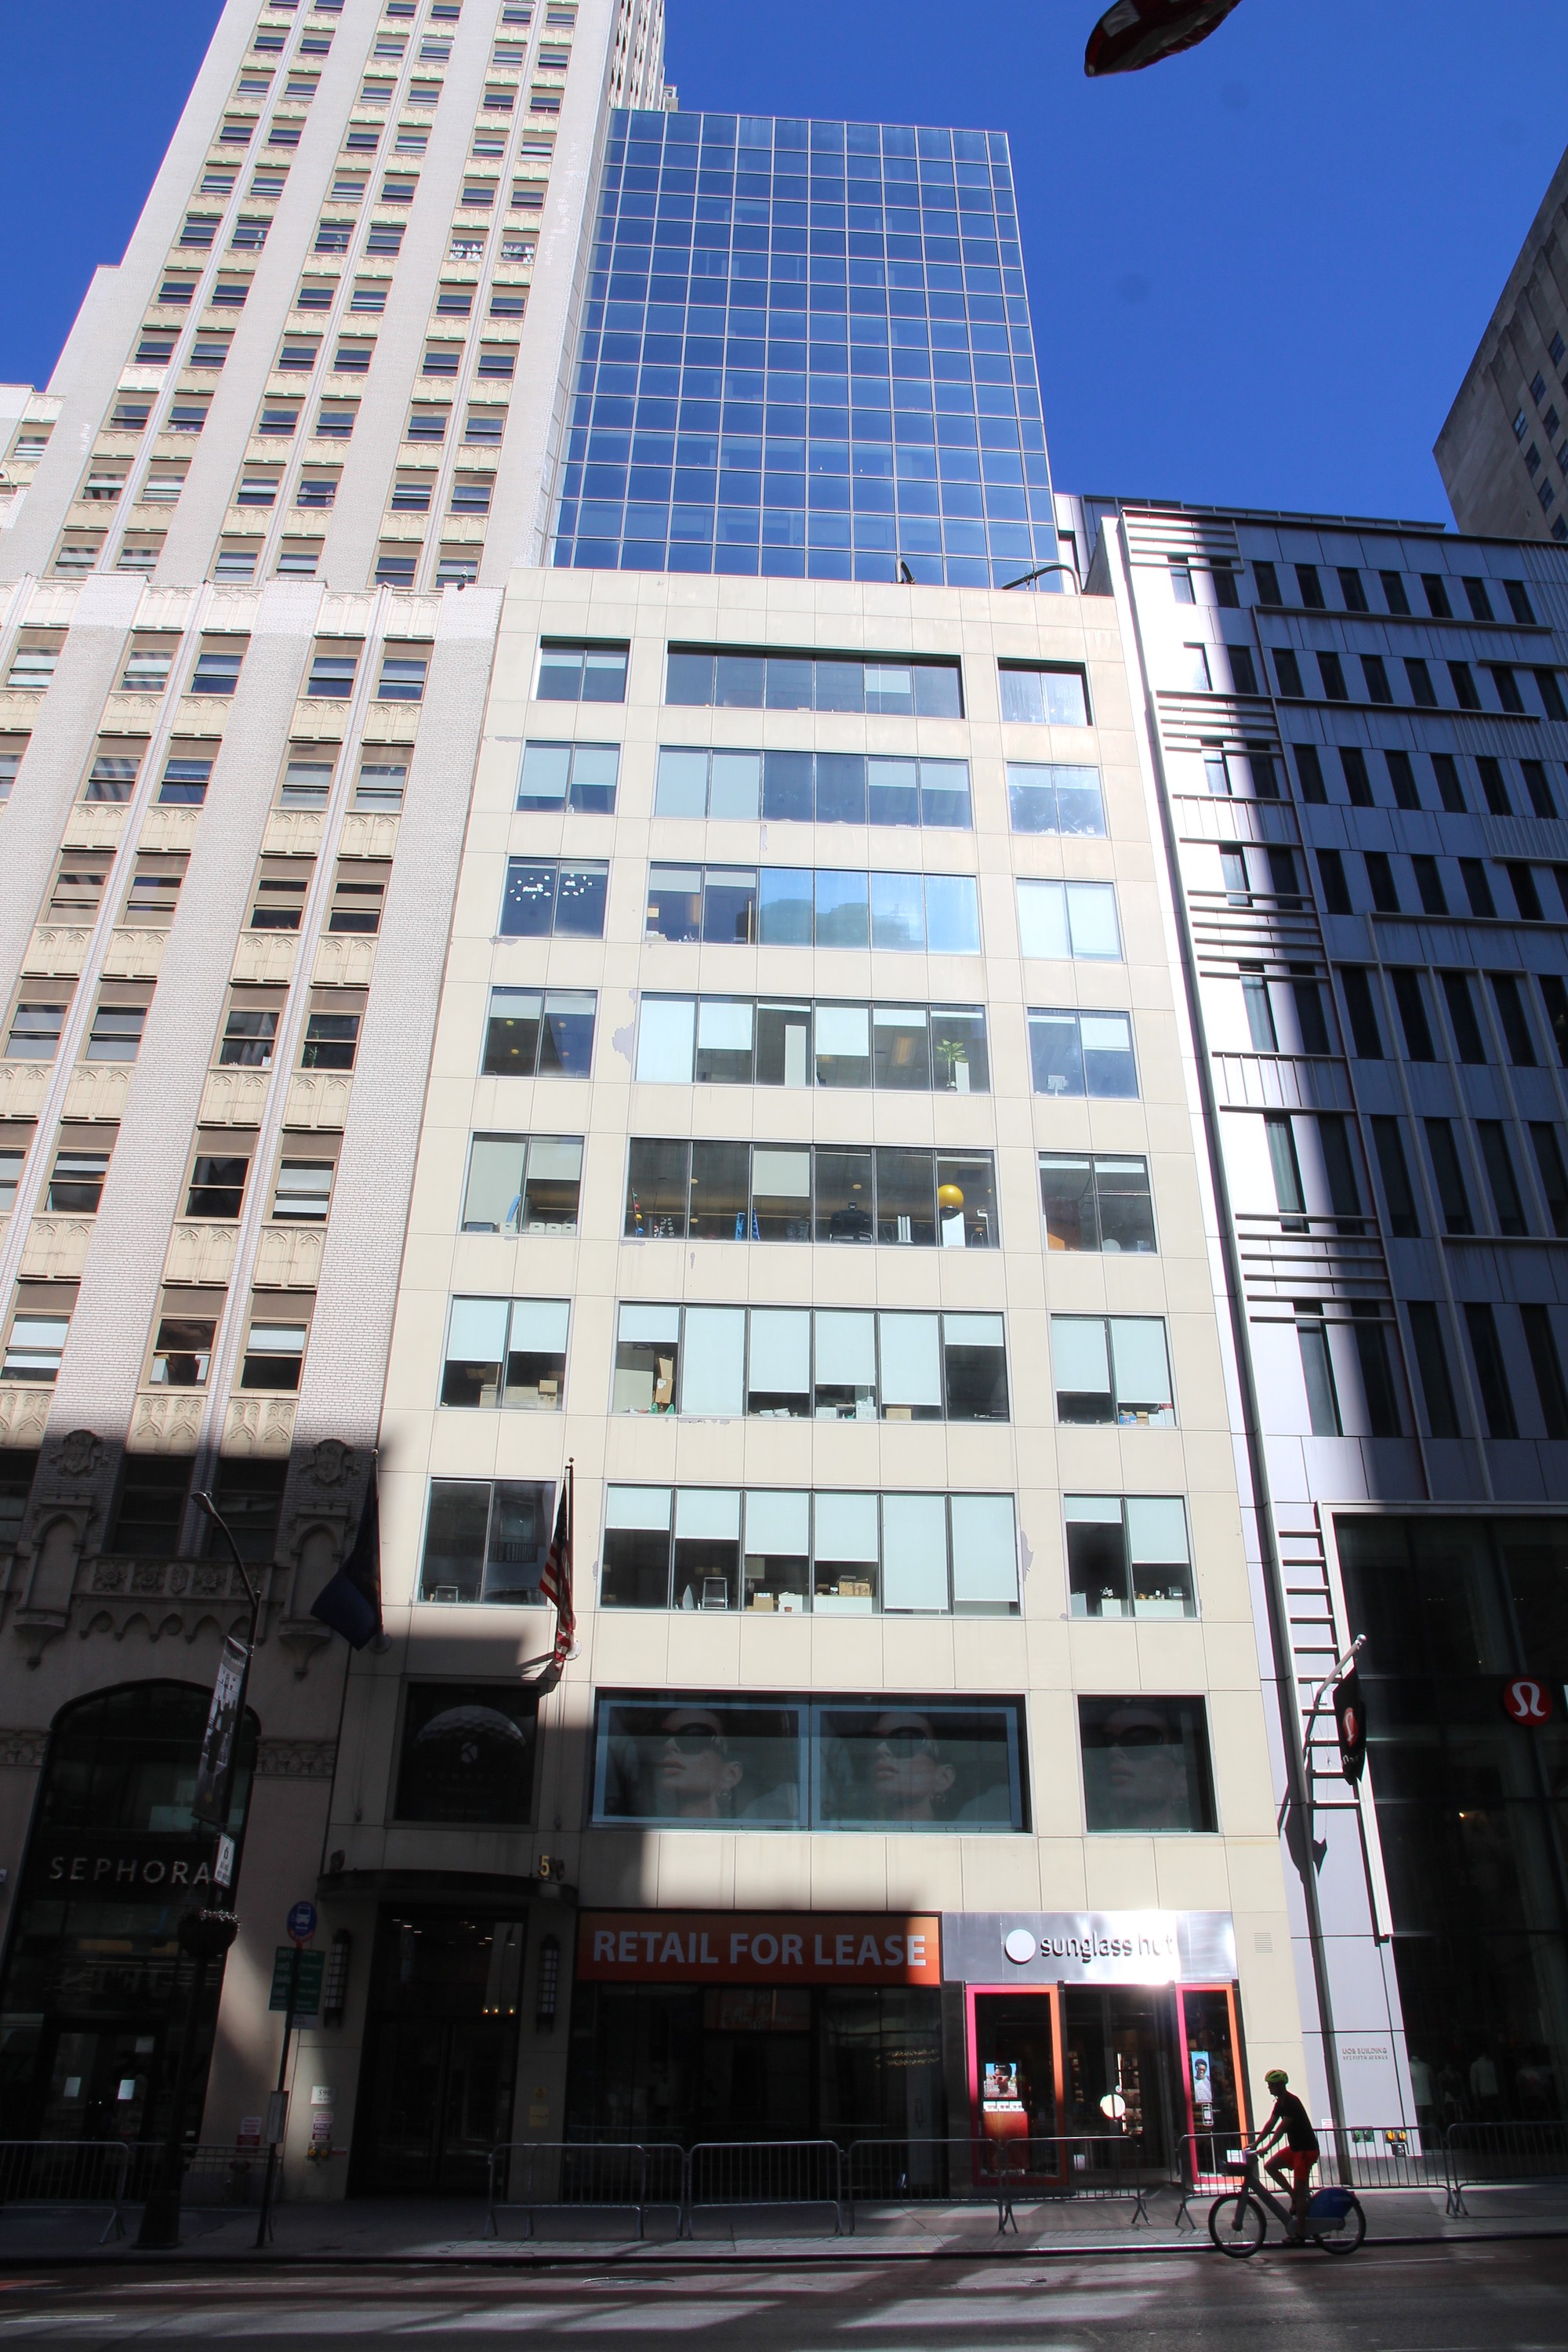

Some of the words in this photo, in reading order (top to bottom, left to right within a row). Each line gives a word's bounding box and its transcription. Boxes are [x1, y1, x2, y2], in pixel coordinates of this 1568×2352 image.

[49, 1856, 210, 1885] SEPHORA
[593, 1930, 719, 1964] RETAIL
[730, 1933, 804, 1965] FOR
[814, 1934, 927, 1967] LEASE
[1040, 1930, 1133, 1963] sunglass
[1138, 1932, 1174, 1957] hut
